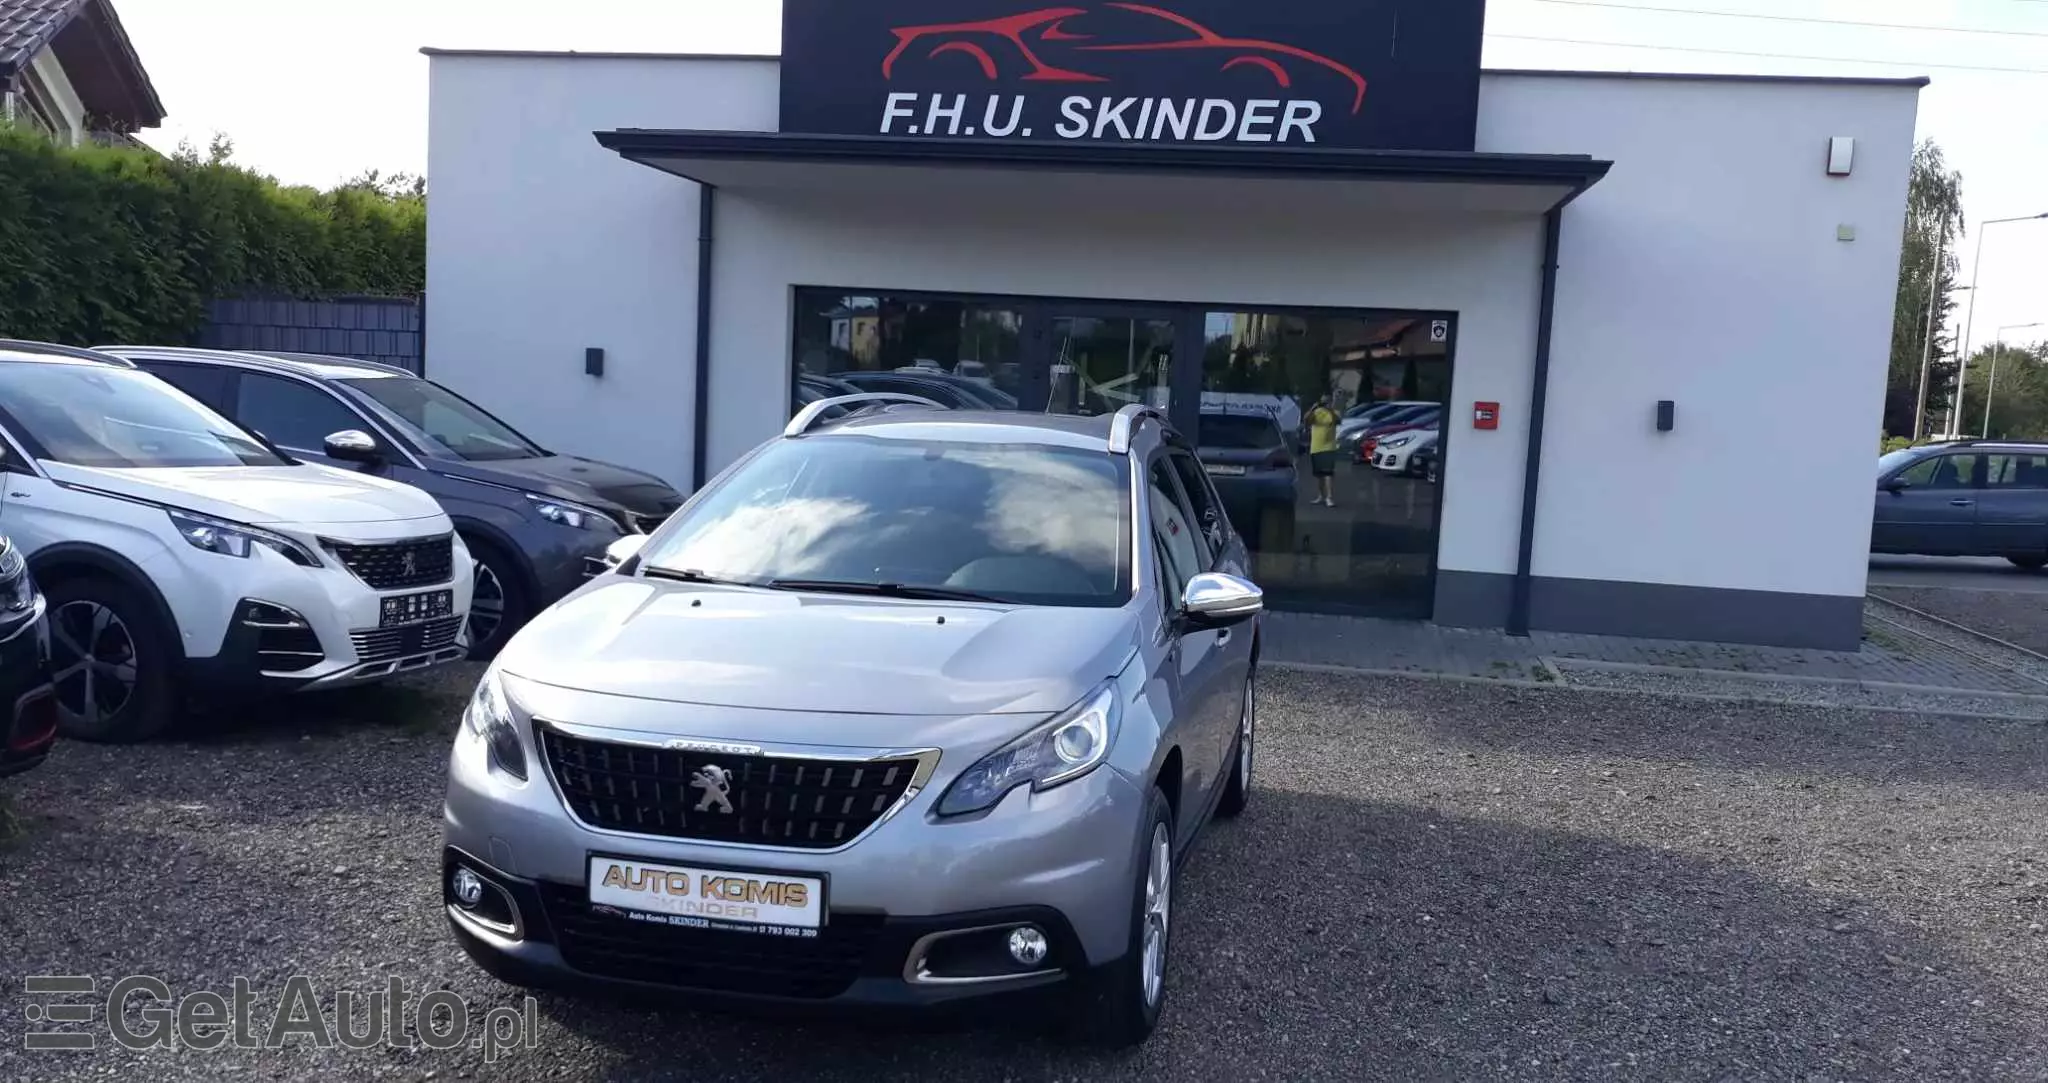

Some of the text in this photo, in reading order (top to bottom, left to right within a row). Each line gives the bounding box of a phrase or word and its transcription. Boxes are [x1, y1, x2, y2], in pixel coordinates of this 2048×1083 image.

[879, 92, 1321, 143] F.H.U. SKINDER
[602, 865, 809, 909] AUTO KOMIS
[629, 912, 645, 921] Auto
[646, 913, 668, 923] Komis
[669, 916, 709, 928] SKINDER
[649, 896, 758, 919] SKINDER
